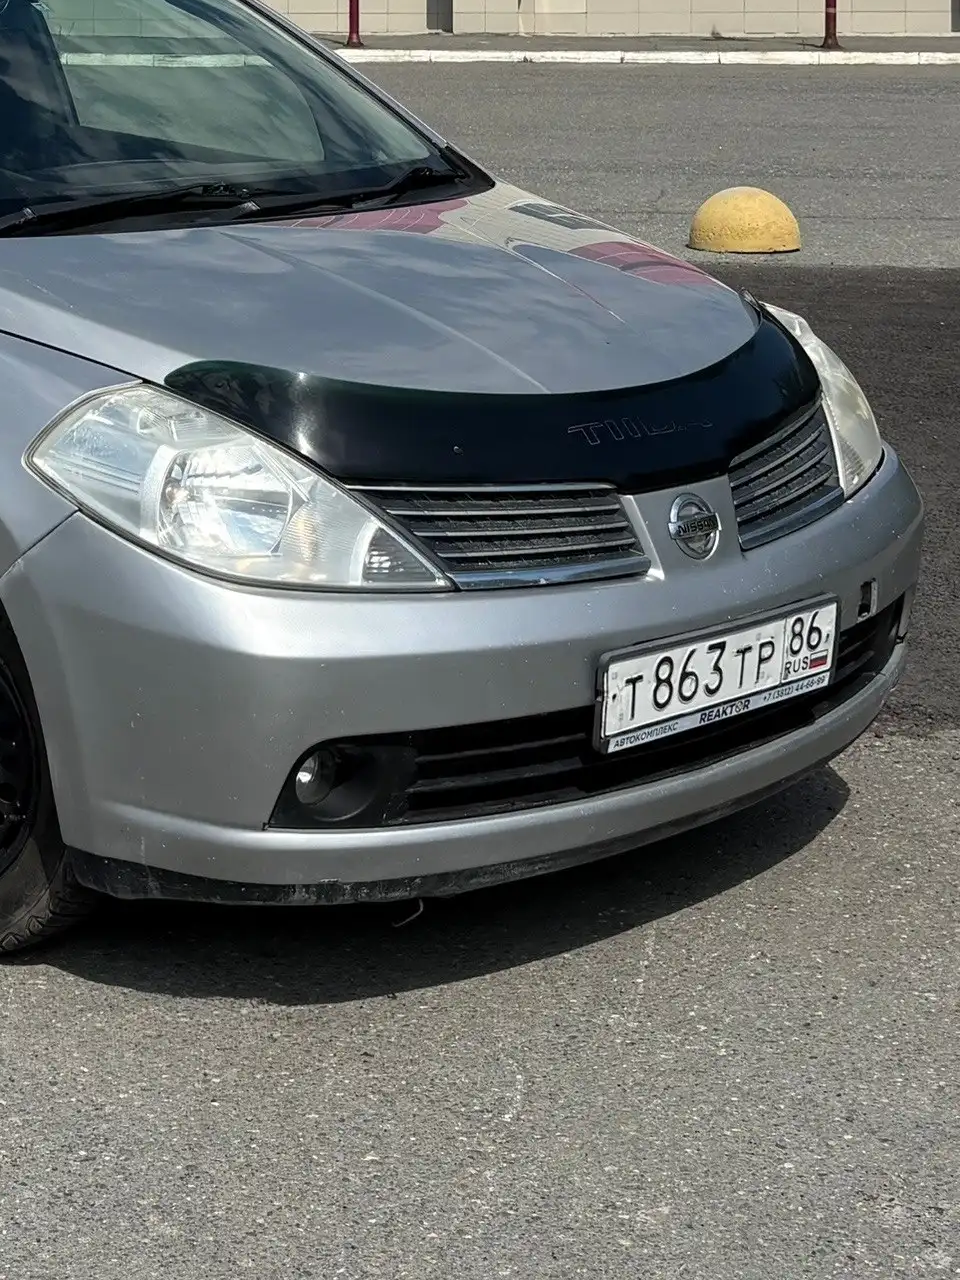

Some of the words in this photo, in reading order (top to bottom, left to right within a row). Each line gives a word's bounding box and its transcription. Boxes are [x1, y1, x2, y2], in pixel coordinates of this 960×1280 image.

[789, 611, 823, 657] 86
[784, 656, 809, 676] RUS
[613, 721, 679, 749] АВТОКОМПЛЕКС
